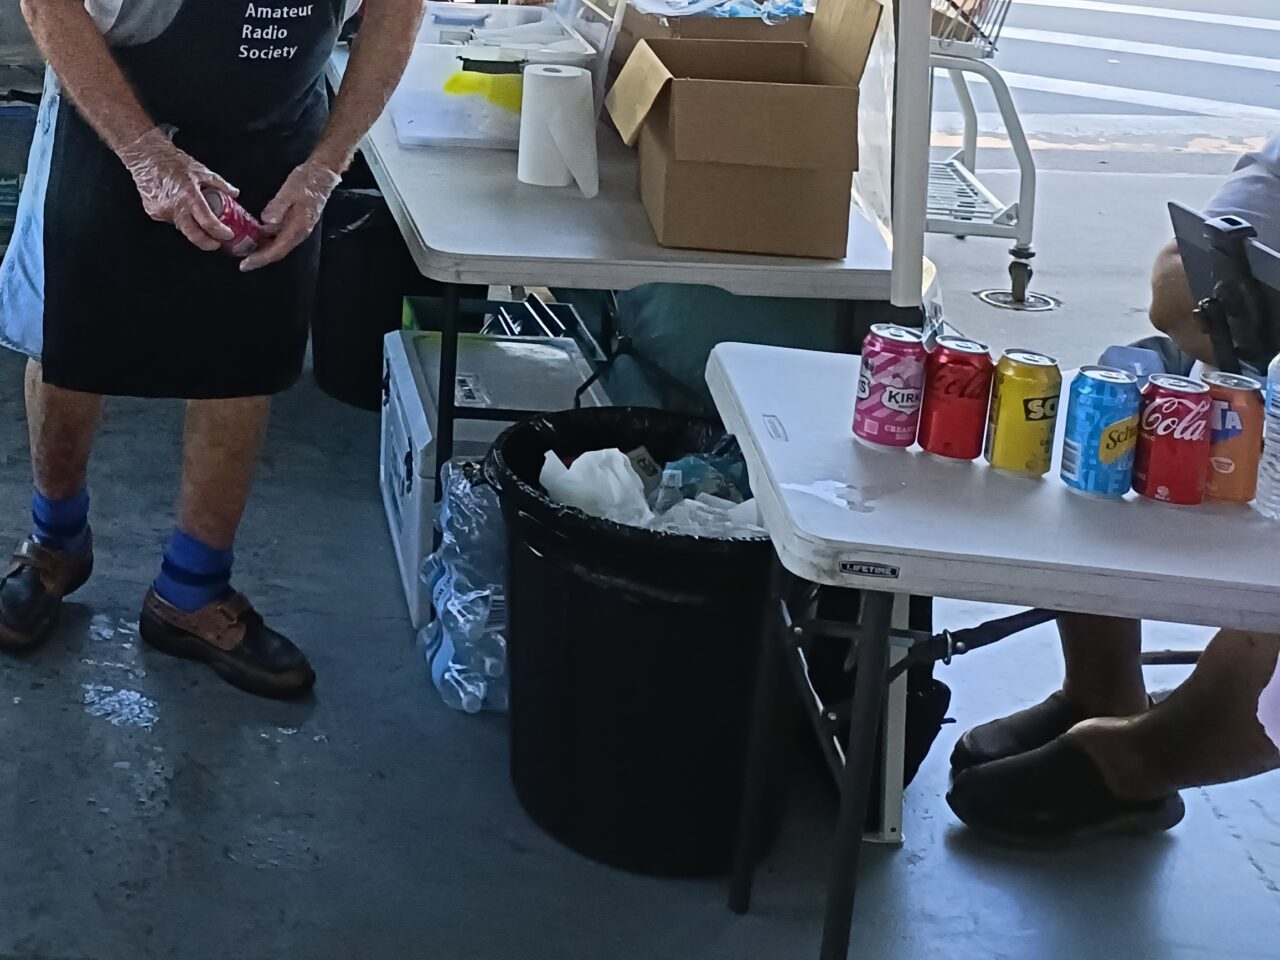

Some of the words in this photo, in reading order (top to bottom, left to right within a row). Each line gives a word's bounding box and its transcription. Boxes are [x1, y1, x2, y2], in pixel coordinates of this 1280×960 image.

[245, 3, 314, 18] Amateur
[242, 24, 288, 39] Radio
[238, 45, 298, 59] Society
[888, 390, 921, 404] KIRK
[1142, 397, 1211, 440] Cola
